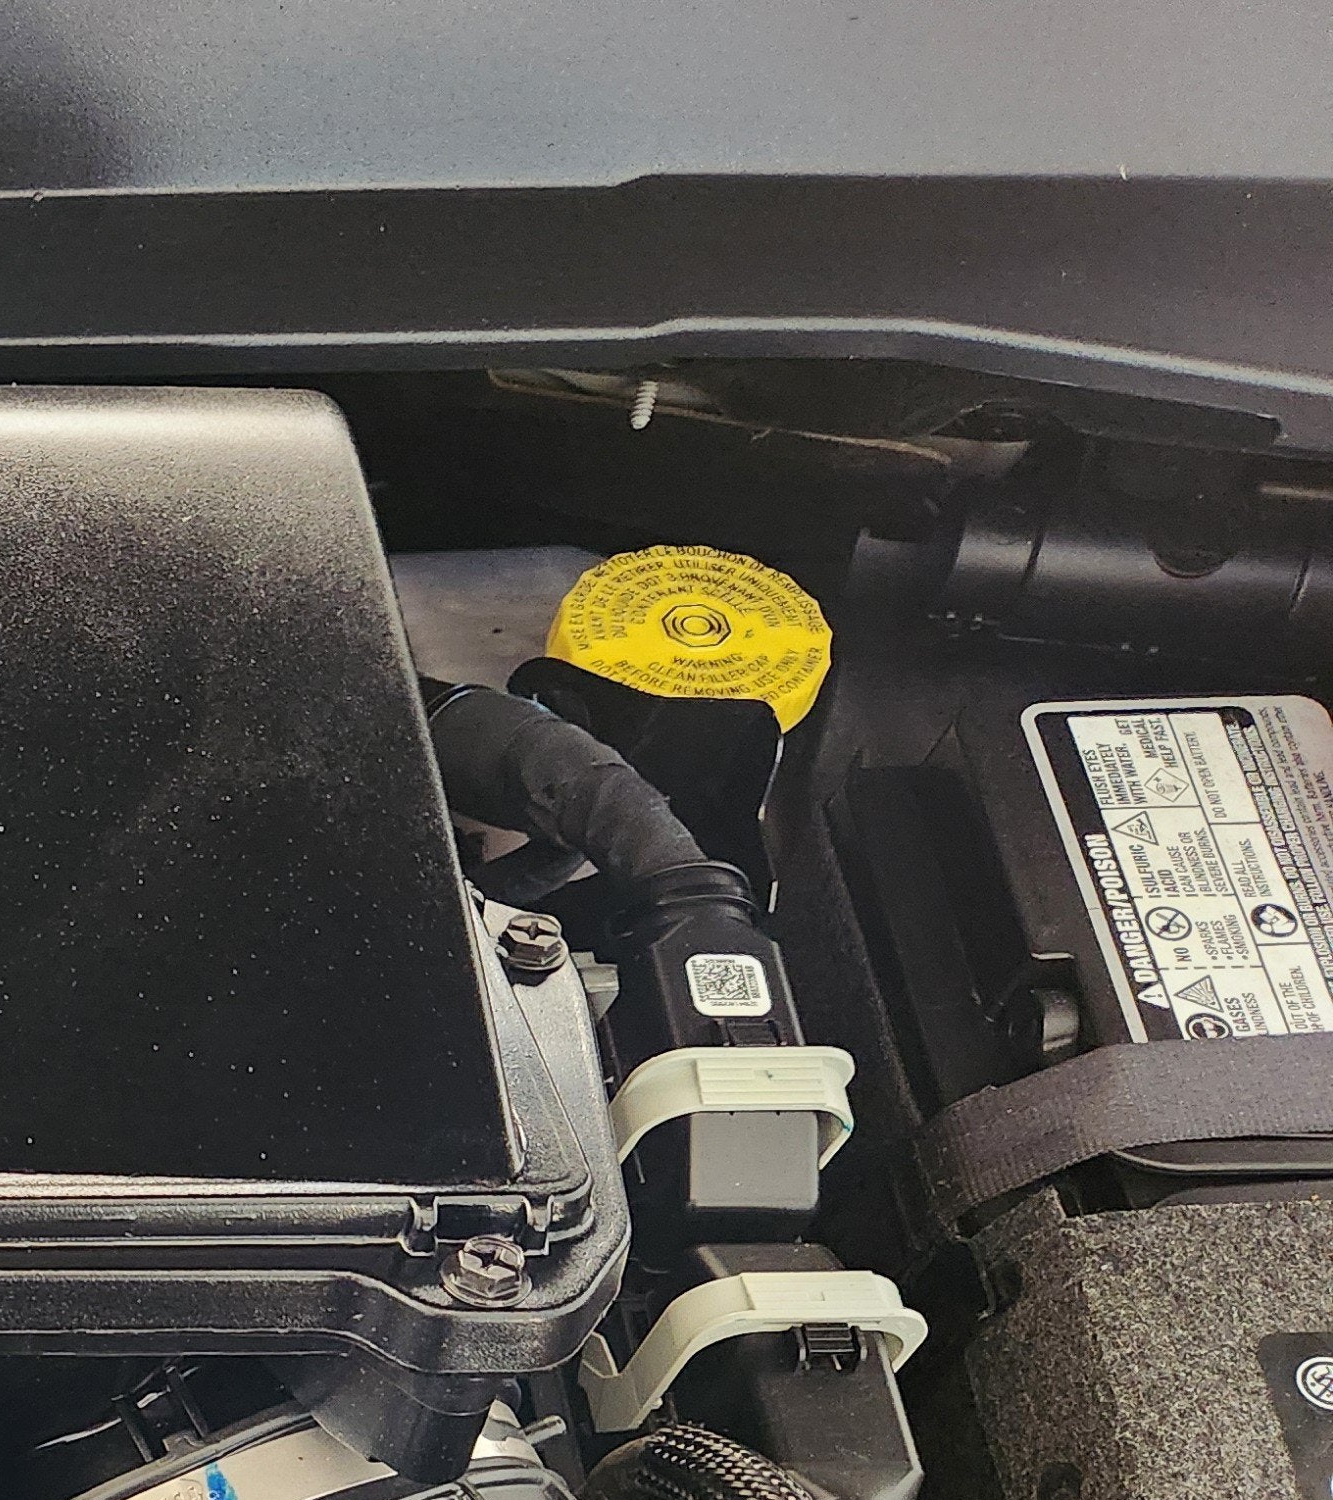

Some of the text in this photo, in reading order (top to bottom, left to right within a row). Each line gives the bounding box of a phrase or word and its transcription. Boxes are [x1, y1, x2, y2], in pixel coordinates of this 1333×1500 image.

[674, 559, 736, 576] UTILISER
[739, 572, 802, 627] UNIQUEMENT
[769, 571, 825, 634] REMPLISSAGE
[614, 659, 667, 690] BEFORE
[754, 669, 777, 689] USE
[776, 648, 800, 674] ONLY
[648, 654, 770, 682] CLEAN FILLER CAP
[1116, 718, 1132, 734] GET
[1132, 718, 1158, 758] MEDICAL
[1149, 717, 1178, 767] HELP FAST.
[1083, 749, 1114, 805] FLUSH EYES
[1097, 742, 1131, 804] IMMEDIATELY
[1114, 743, 1147, 804] WITH WATER.
[1198, 767, 1215, 786] OPEN
[1206, 788, 1222, 804] NOT
[1213, 807, 1227, 817] DO
[1129, 844, 1160, 892] SULFURIC
[1167, 846, 1195, 892] CAN CAUSE
[1178, 831, 1211, 891] BLINDNESS OR
[1193, 827, 1228, 891] SEVERE BURNS.
[1232, 860, 1256, 897] READ ALL
[1239, 838, 1272, 896] INSTRUCTIONS.
[1158, 869, 1178, 892] ACID
[1083, 833, 1158, 982] DANGER/POISON
[1173, 947, 1191, 962] NO
[1196, 921, 1219, 954] SPARKS
[1211, 920, 1233, 954] FLAMES
[1224, 914, 1249, 953] SMOKING
[1280, 982, 1308, 1028] OUT OF THE
[1289, 966, 1316, 1009] CHILDREN.
[1224, 997, 1251, 1031] GASES
[1307, 1011, 1321, 1021] OF
